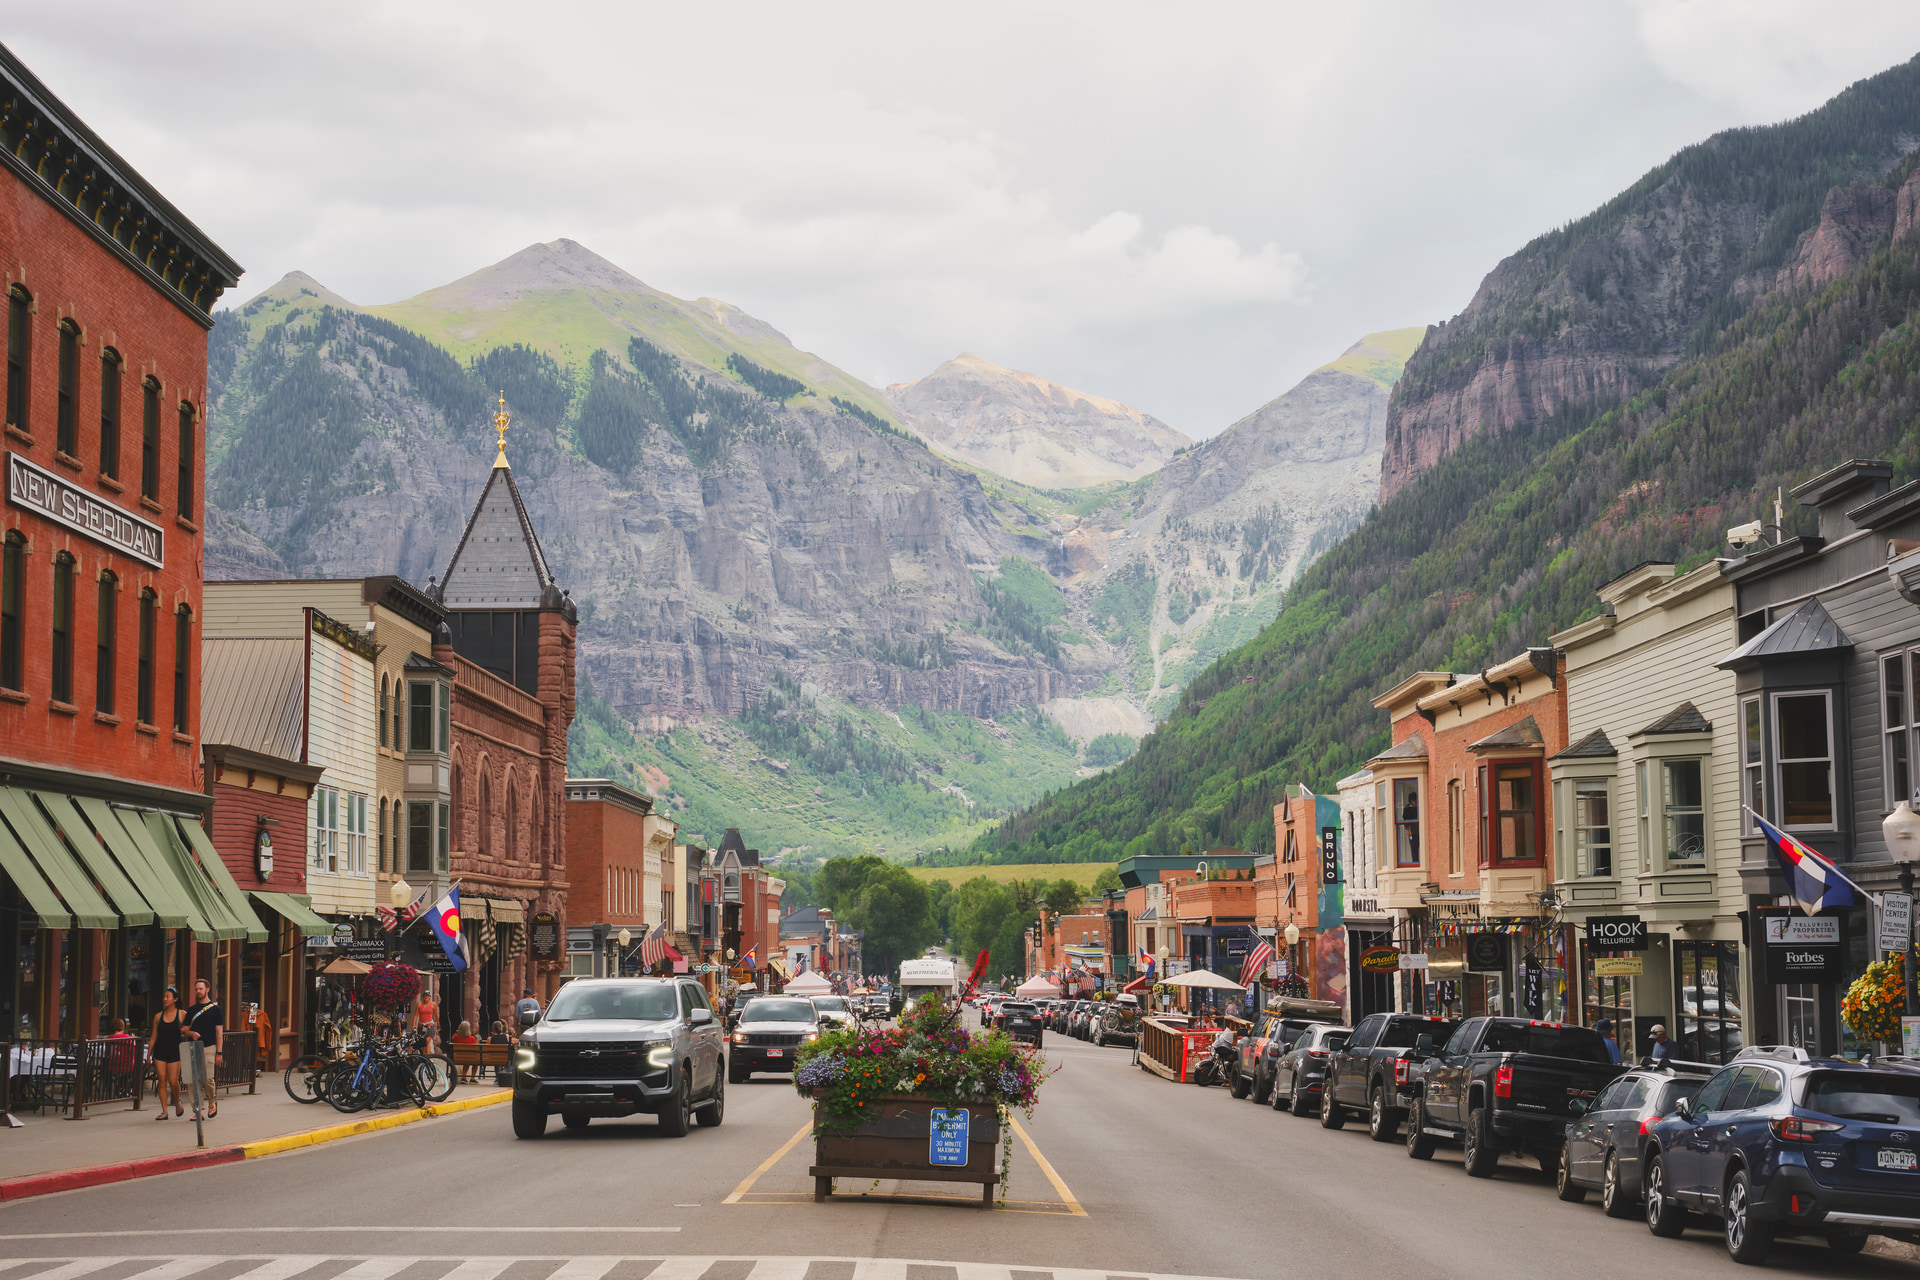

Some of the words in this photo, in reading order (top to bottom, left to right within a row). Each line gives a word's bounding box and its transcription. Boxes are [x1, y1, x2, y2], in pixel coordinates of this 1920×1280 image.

[12, 463, 57, 511] NEW
[1325, 832, 1335, 879] BRUNO
[1886, 900, 1908, 909] VISITOR
[1885, 910, 1908, 918] CENTER
[1592, 922, 1642, 937] HOOK
[310, 936, 328, 945] TRIPS
[1599, 936, 1635, 945] TELLURIDE
[1786, 952, 1824, 962] Forbes
[1701, 968, 1718, 986] HOOK
[1566, 1087, 1597, 1098] GMC
[943, 1122, 967, 1130] PERMIT
[941, 1130, 957, 1139] ONLY
